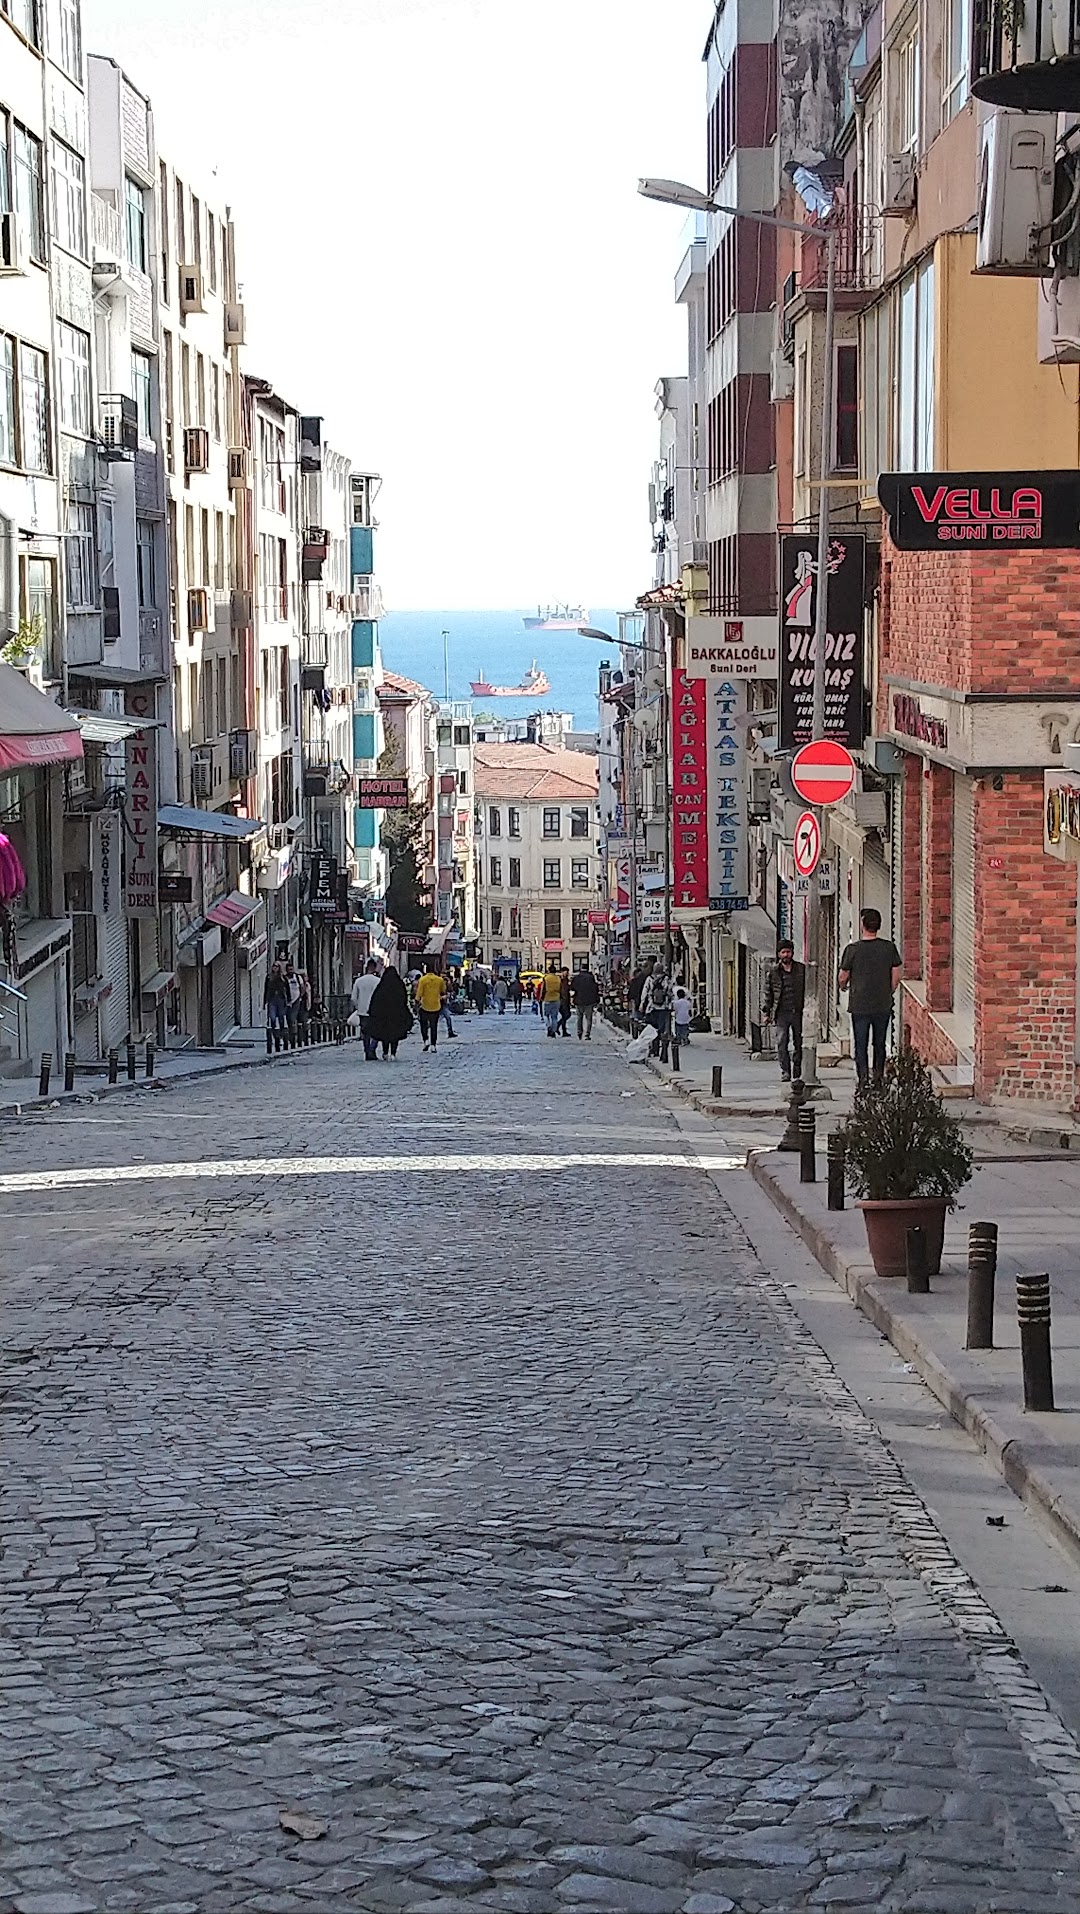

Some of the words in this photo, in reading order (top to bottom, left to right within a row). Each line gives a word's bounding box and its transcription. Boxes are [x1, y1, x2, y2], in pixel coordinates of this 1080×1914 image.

[911, 486, 1042, 523] VELLA
[691, 645, 776, 660] BAKKALOĞLU
[736, 664, 757, 673] Deri
[714, 682, 739, 767] ATLAS
[361, 780, 407, 793] HOTEL
[675, 794, 702, 805] CAN
[678, 812, 701, 904] METAL
[317, 861, 331, 897] EFEM
